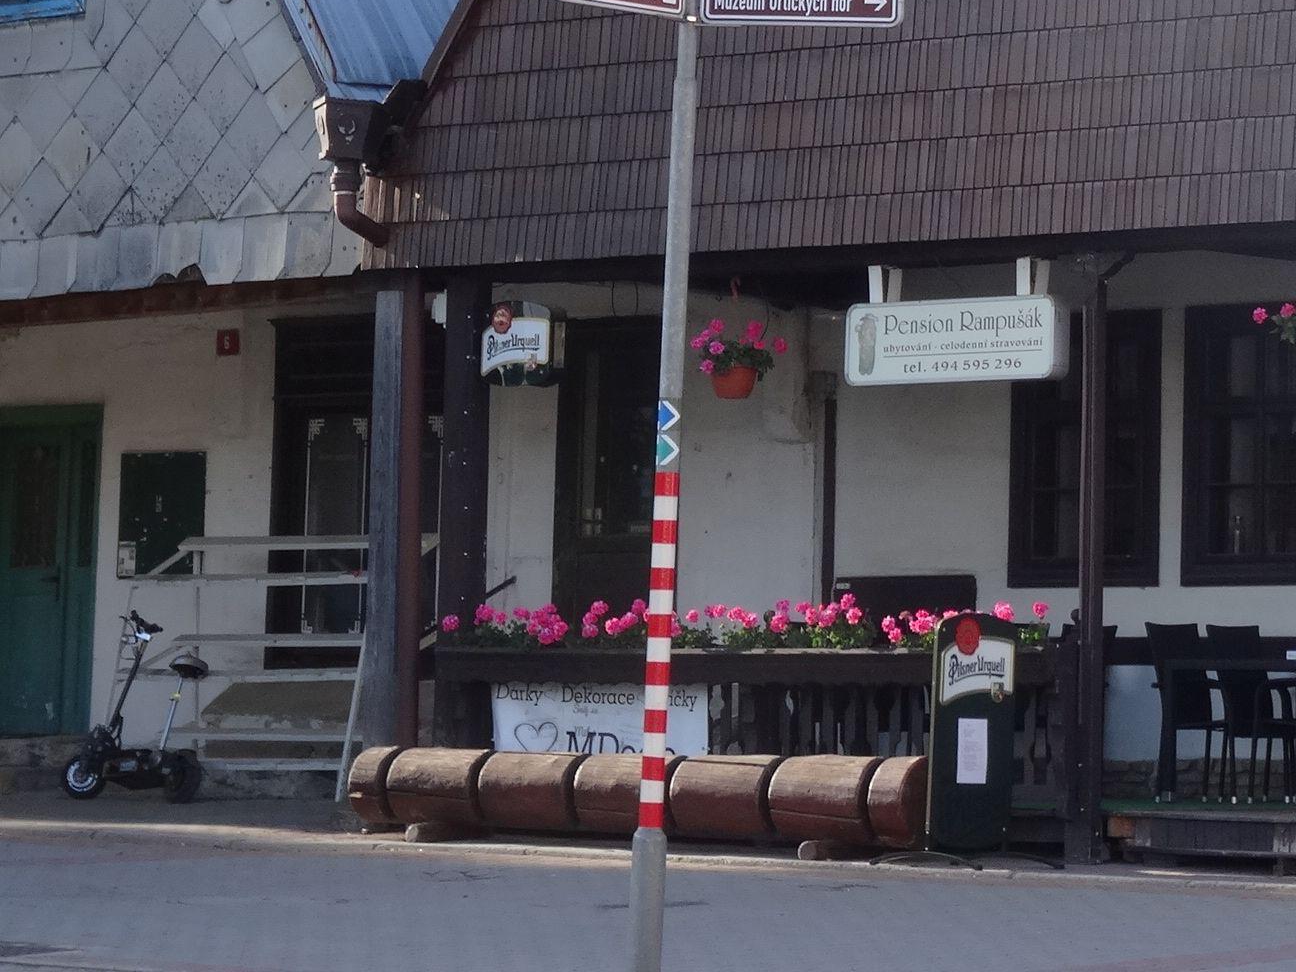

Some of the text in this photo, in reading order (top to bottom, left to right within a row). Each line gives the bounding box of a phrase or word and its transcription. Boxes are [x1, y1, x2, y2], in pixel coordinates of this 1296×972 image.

[884, 306, 1043, 337] Pension Rampušák
[511, 333, 540, 352] Urquell
[883, 343, 932, 355] ubytování
[940, 339, 988, 350] celodenní
[990, 336, 1044, 349] stravování
[903, 357, 1023, 374] tel. 494 595 296
[948, 654, 1006, 686] Pilsner Urquell
[561, 684, 635, 706] Dekorace
